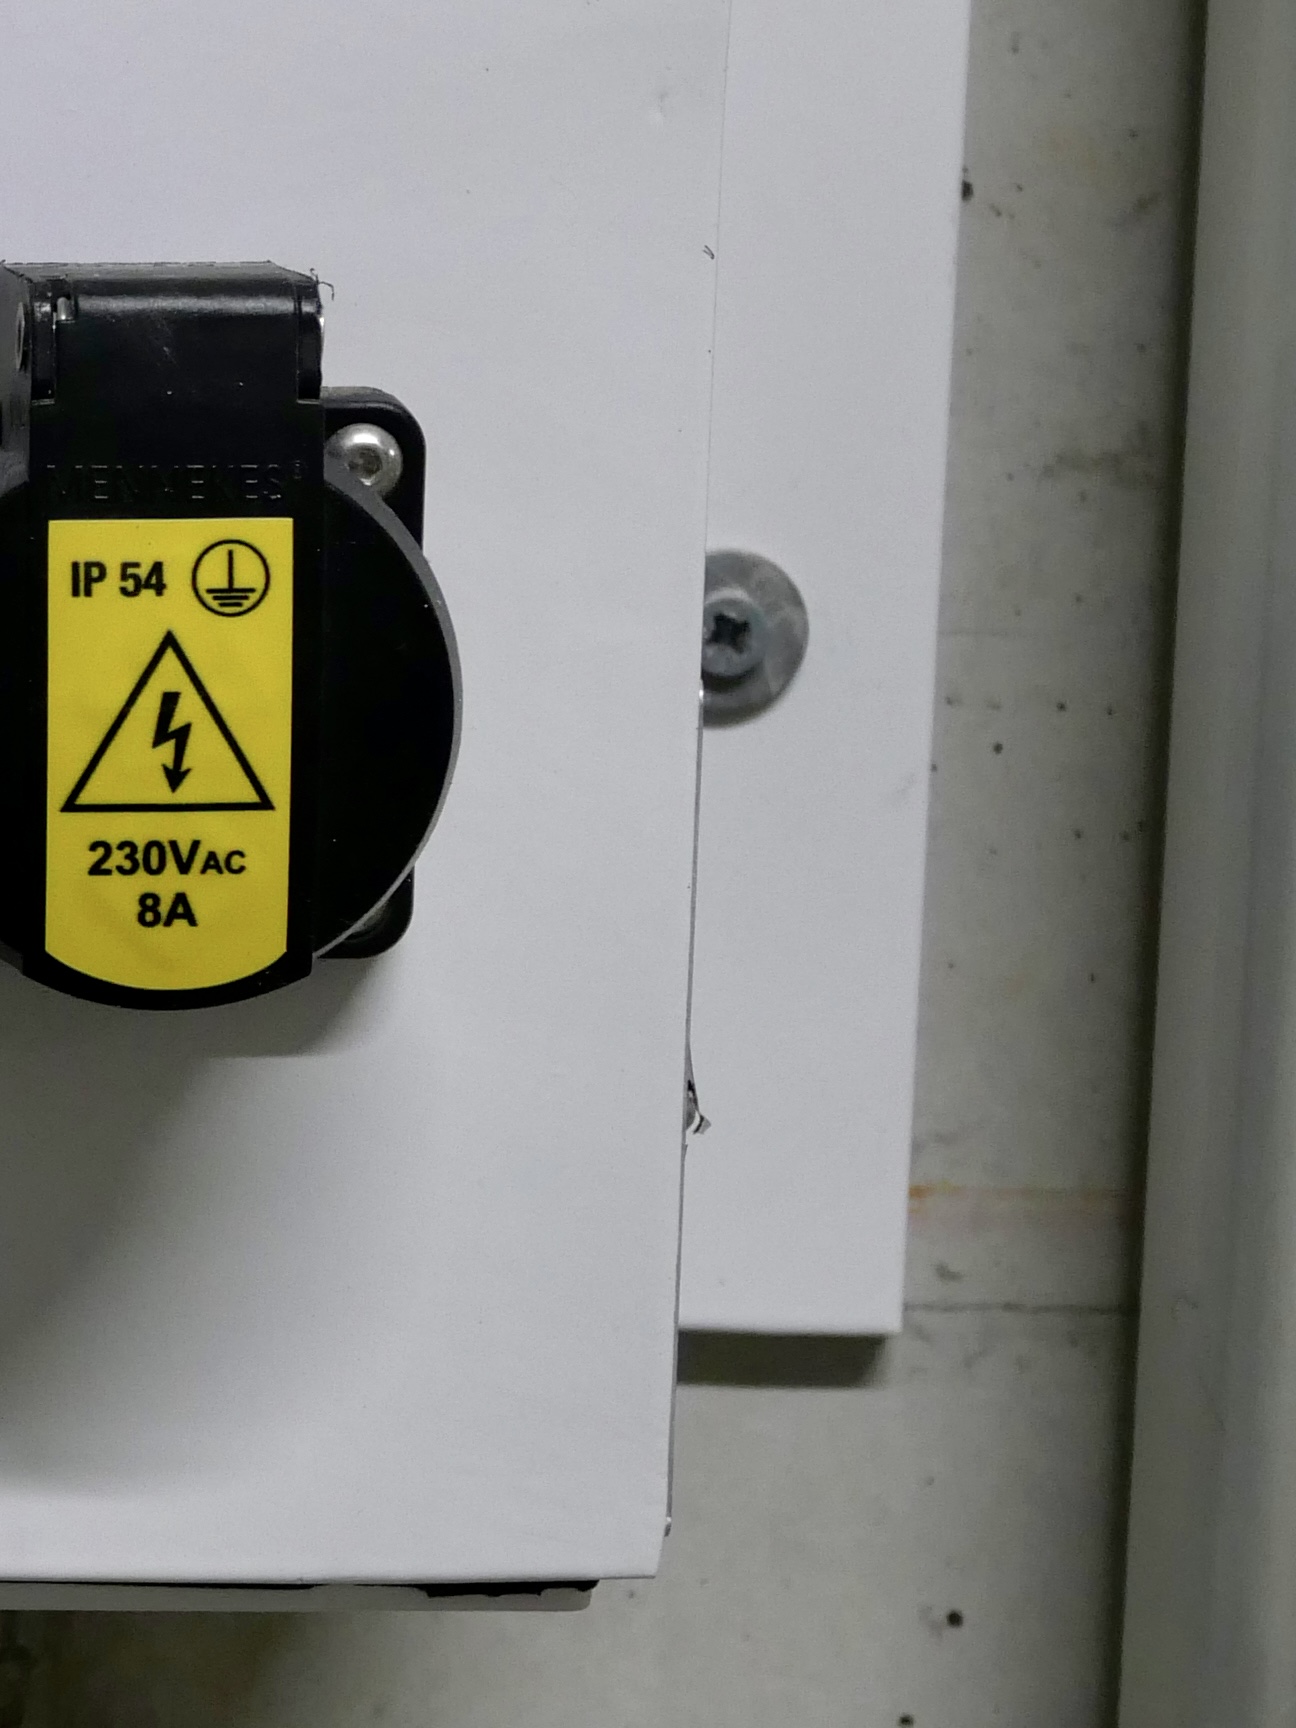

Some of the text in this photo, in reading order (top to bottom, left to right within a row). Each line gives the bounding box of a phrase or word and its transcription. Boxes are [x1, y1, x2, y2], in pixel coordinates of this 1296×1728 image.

[71, 560, 167, 598] IP 54
[87, 839, 247, 877] 230VAC
[136, 891, 199, 929] 8A
